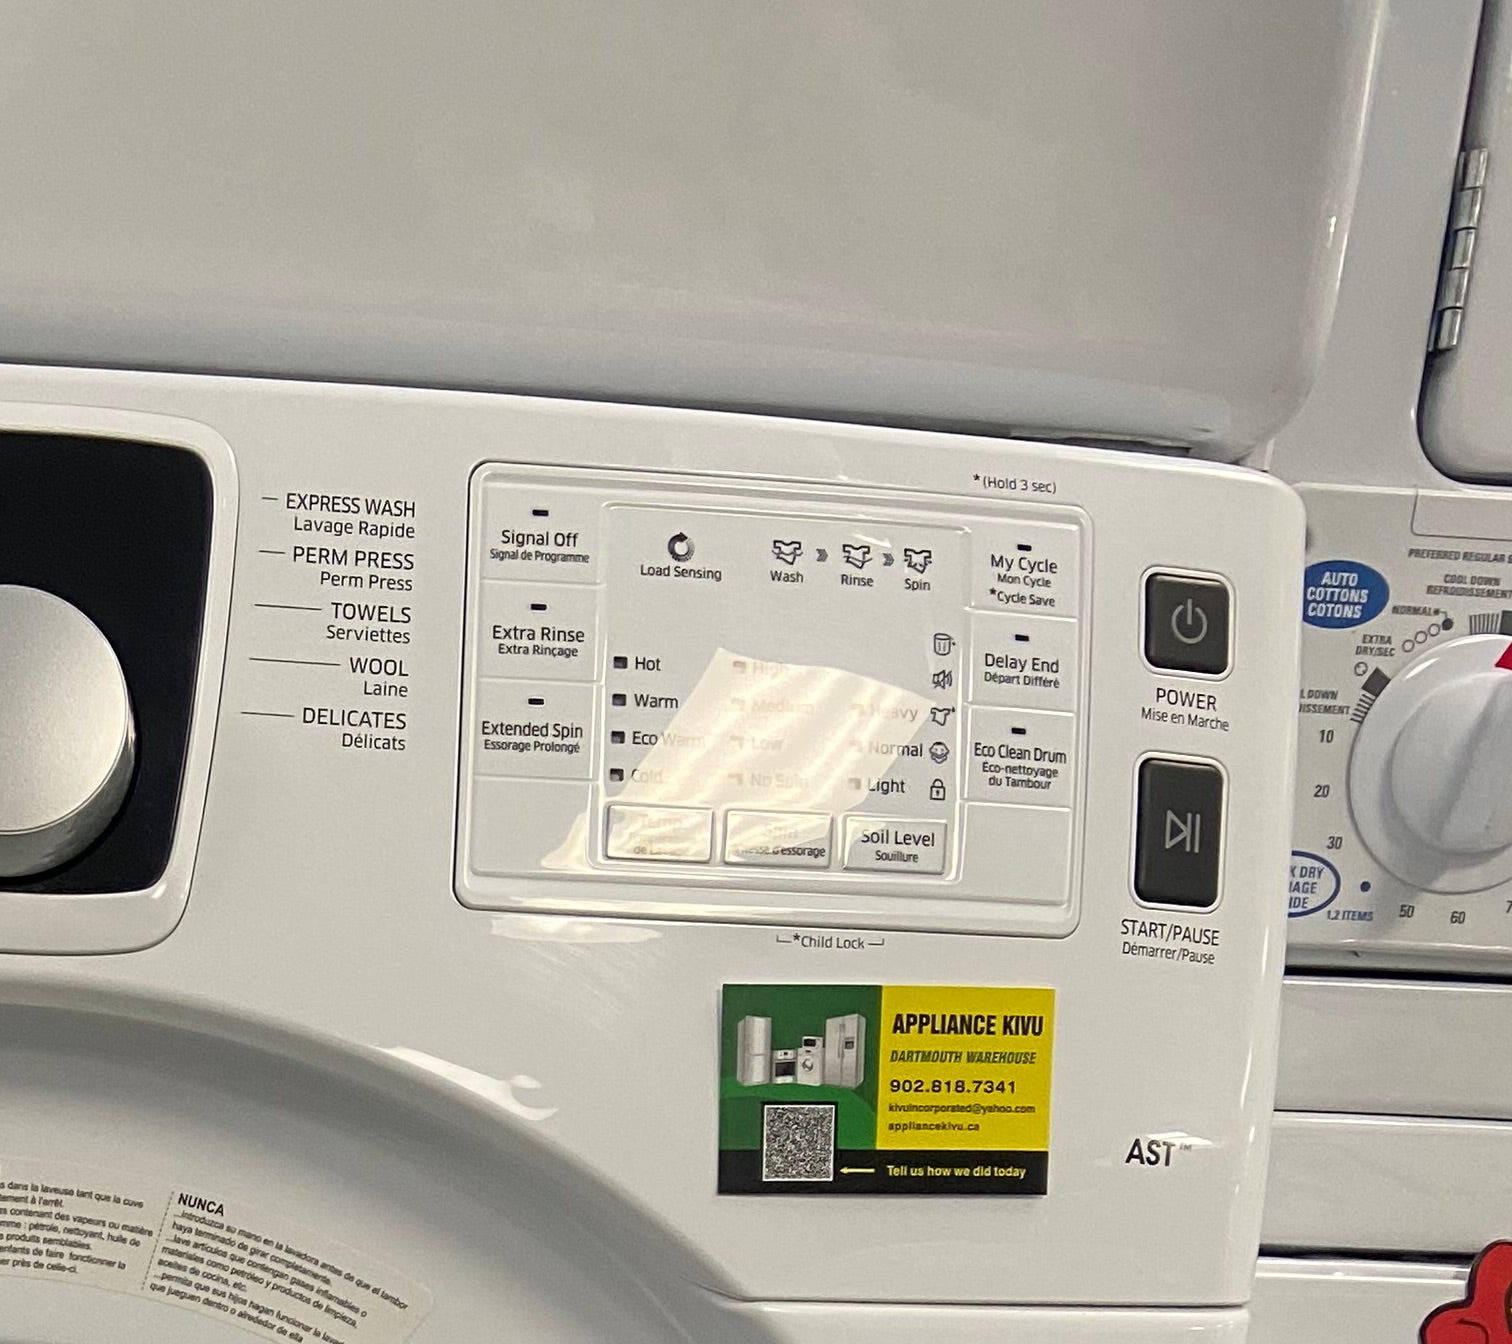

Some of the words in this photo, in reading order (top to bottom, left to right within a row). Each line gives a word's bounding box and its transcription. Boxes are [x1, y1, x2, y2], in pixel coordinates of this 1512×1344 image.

[1021, 479, 1028, 491] 3
[1032, 482, 1056, 494] sec)
[287, 493, 360, 514] EXPRESS
[365, 499, 415, 517] WASH
[295, 516, 353, 536] Lavage
[359, 521, 414, 539] Rapide
[502, 530, 548, 547] Signal
[554, 533, 578, 547] Off
[294, 546, 347, 565] PERM
[355, 550, 413, 570] PRESS
[490, 548, 518, 561] Signal
[521, 550, 532, 560] de
[535, 551, 589, 563] Programme
[991, 554, 1014, 571] My
[1019, 557, 1057, 574] Cycle
[321, 571, 363, 588] Perm
[369, 575, 412, 591] Press
[641, 565, 670, 576] Load
[674, 566, 721, 582] Sensing
[770, 571, 803, 582] Wash
[841, 574, 873, 587] Rinse
[998, 573, 1020, 584] Mon
[1023, 576, 1051, 588] Cycle
[1321, 572, 1358, 586] AUTO
[905, 578, 930, 591] Spin
[1029, 594, 1055, 607] Save
[1307, 587, 1368, 603] COTTONS
[331, 602, 410, 623] TOWELS
[1308, 603, 1362, 618] COTONS
[327, 625, 410, 644] Serviettes
[493, 625, 535, 640] Extra
[541, 627, 584, 642] Rinse
[499, 643, 529, 655] Extra
[533, 645, 578, 658] Rinçage
[350, 657, 408, 676] WOOL
[636, 657, 660, 671] Hot
[985, 653, 1027, 672] Delay
[1032, 658, 1059, 673] End
[984, 672, 1020, 685] Départ
[1023, 675, 1059, 688] Différé
[364, 681, 408, 697] Laine
[634, 694, 678, 708] Warm
[1157, 688, 1216, 711] POWER
[303, 707, 406, 729] DELICATES
[1142, 707, 1168, 722] Mise
[1171, 713, 1184, 724] en
[1188, 714, 1229, 731] Marche
[482, 721, 548, 737] Extended
[552, 723, 582, 740] Spin
[632, 731, 658, 745] Eco
[1320, 730, 1334, 743] 10
[342, 733, 405, 750] Délicats
[484, 739, 531, 752] Essorage
[534, 741, 580, 754] Prolongé
[868, 740, 923, 758] Normal
[975, 742, 995, 757] Eco
[998, 744, 1030, 760] Clean
[1034, 748, 1066, 763] Drum
[868, 778, 906, 794] Light
[989, 776, 1002, 786] du
[1005, 776, 1051, 789] Tambour
[1314, 785, 1330, 798] 20
[861, 830, 889, 844] Soil
[895, 831, 934, 847] Level
[1327, 836, 1342, 849] 30
[875, 850, 918, 863] Souillure
[1300, 866, 1324, 879] DRY
[1398, 904, 1415, 918] 50
[1506, 900, 1512, 914] 7
[1450, 911, 1465, 924] 60
[1120, 919, 1220, 946] START/PAUSE
[837, 938, 864, 949] Lock
[1122, 942, 1215, 965] Démarrer/Pause
[892, 1014, 996, 1035] APPLIANCE
[1003, 1015, 1043, 1036] KIVU
[890, 1050, 962, 1063] DARTMOUTH
[967, 1051, 1036, 1064] WAREHOUSE
[890, 1079, 1014, 1094] 902.818.7341
[887, 1165, 907, 1176] Tell
[910, 1168, 923, 1176] us
[927, 1166, 951, 1176] how
[953, 1168, 970, 1176] we
[973, 1167, 991, 1176] did
[994, 1167, 1026, 1179] today
[178, 1193, 225, 1216] NUNCA
